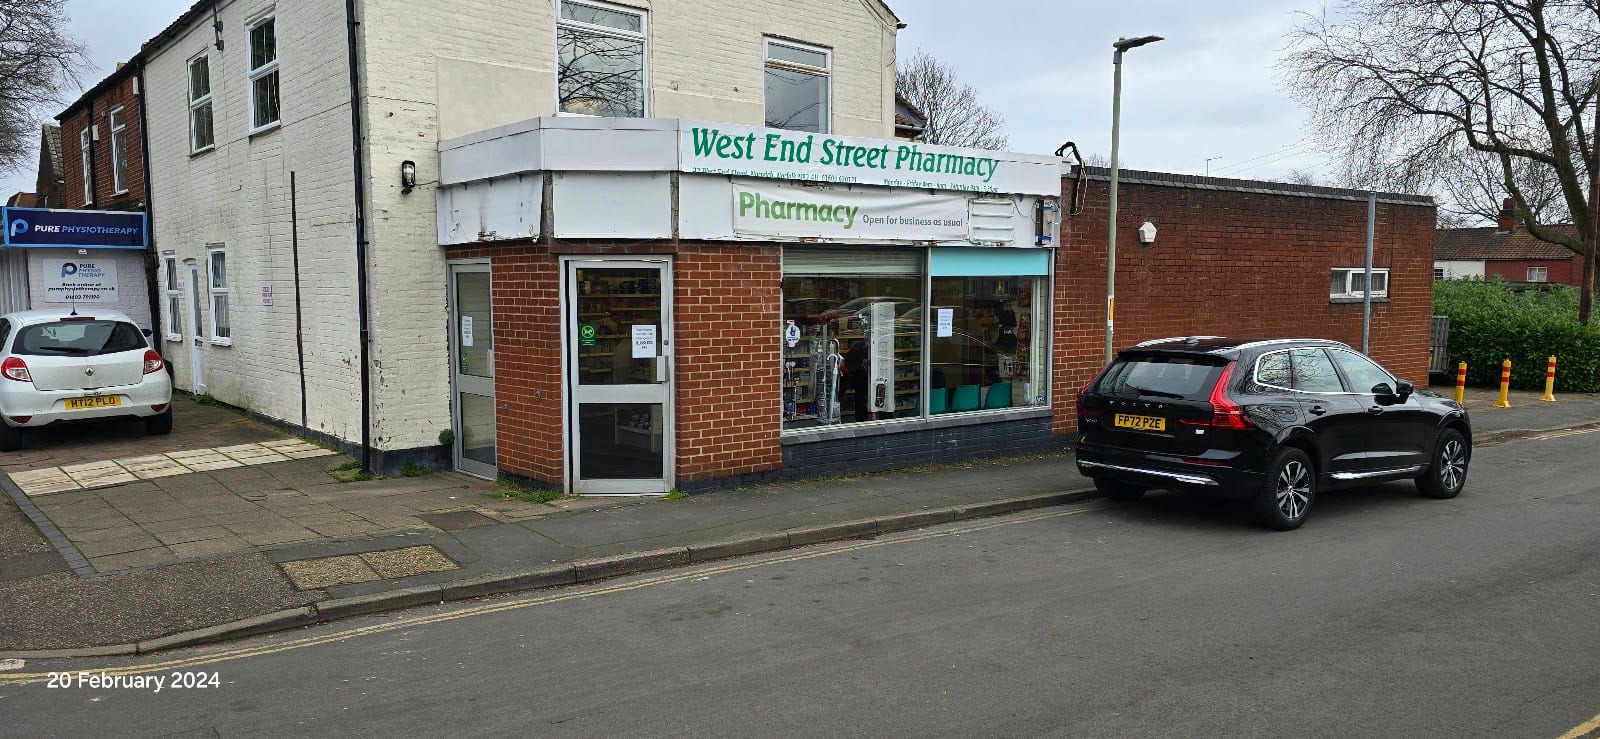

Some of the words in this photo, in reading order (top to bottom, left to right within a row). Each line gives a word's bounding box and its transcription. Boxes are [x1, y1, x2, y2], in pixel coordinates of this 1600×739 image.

[691, 127, 756, 160] West
[763, 133, 814, 163] End
[820, 138, 889, 169] Street
[895, 144, 1001, 183] Pharmacy
[739, 191, 859, 229] Pharmacy
[862, 214, 886, 226] Open
[886, 216, 898, 225] for
[900, 216, 932, 226] business
[944, 218, 963, 226] usual
[34, 224, 60, 232] PURE
[62, 226, 138, 234] PHYSIOTHERAPY
[71, 398, 94, 408] MT12
[1118, 415, 1140, 426] FP72
[1143, 417, 1161, 428] PZE
